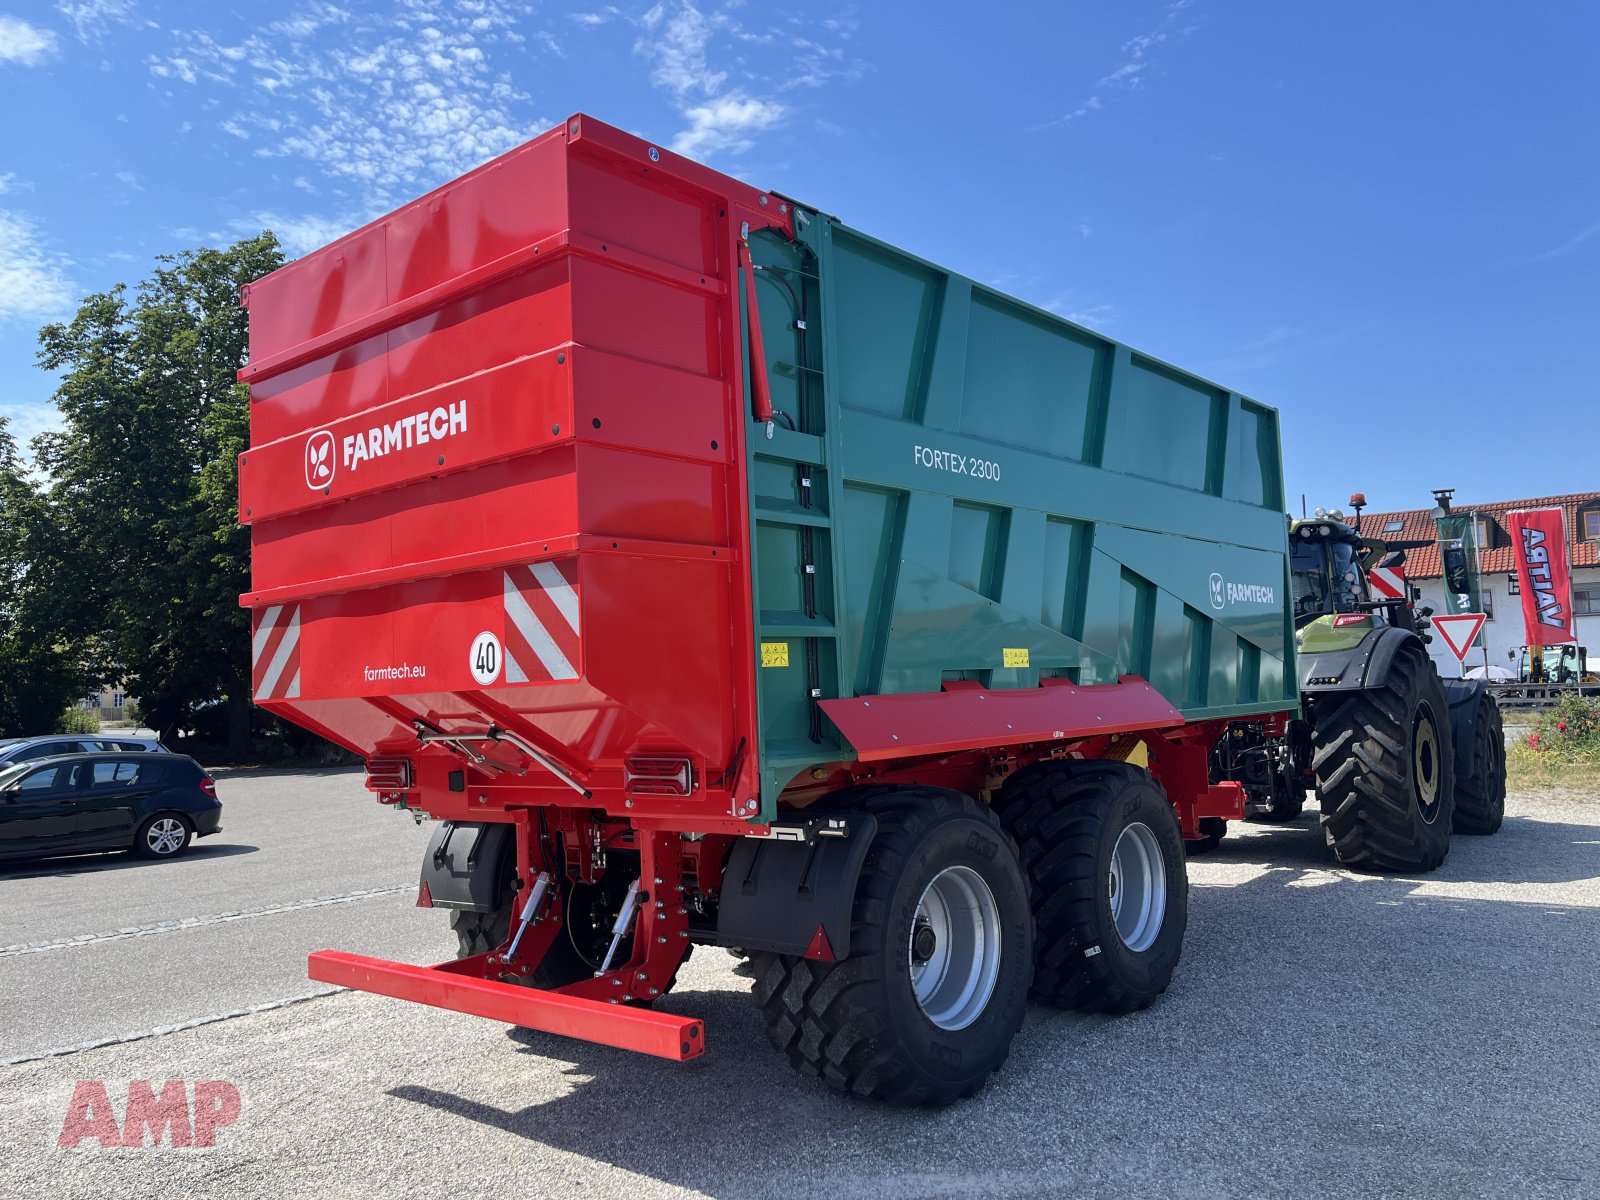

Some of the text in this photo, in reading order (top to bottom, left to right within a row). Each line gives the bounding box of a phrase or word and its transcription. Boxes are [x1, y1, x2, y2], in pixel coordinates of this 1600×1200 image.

[343, 399, 468, 471] FARMTECH
[914, 445, 1001, 481] FORTEX 2300
[1226, 582, 1274, 604] FARMTECH
[363, 662, 427, 681] farmtech.eu
[475, 641, 496, 674] 40
